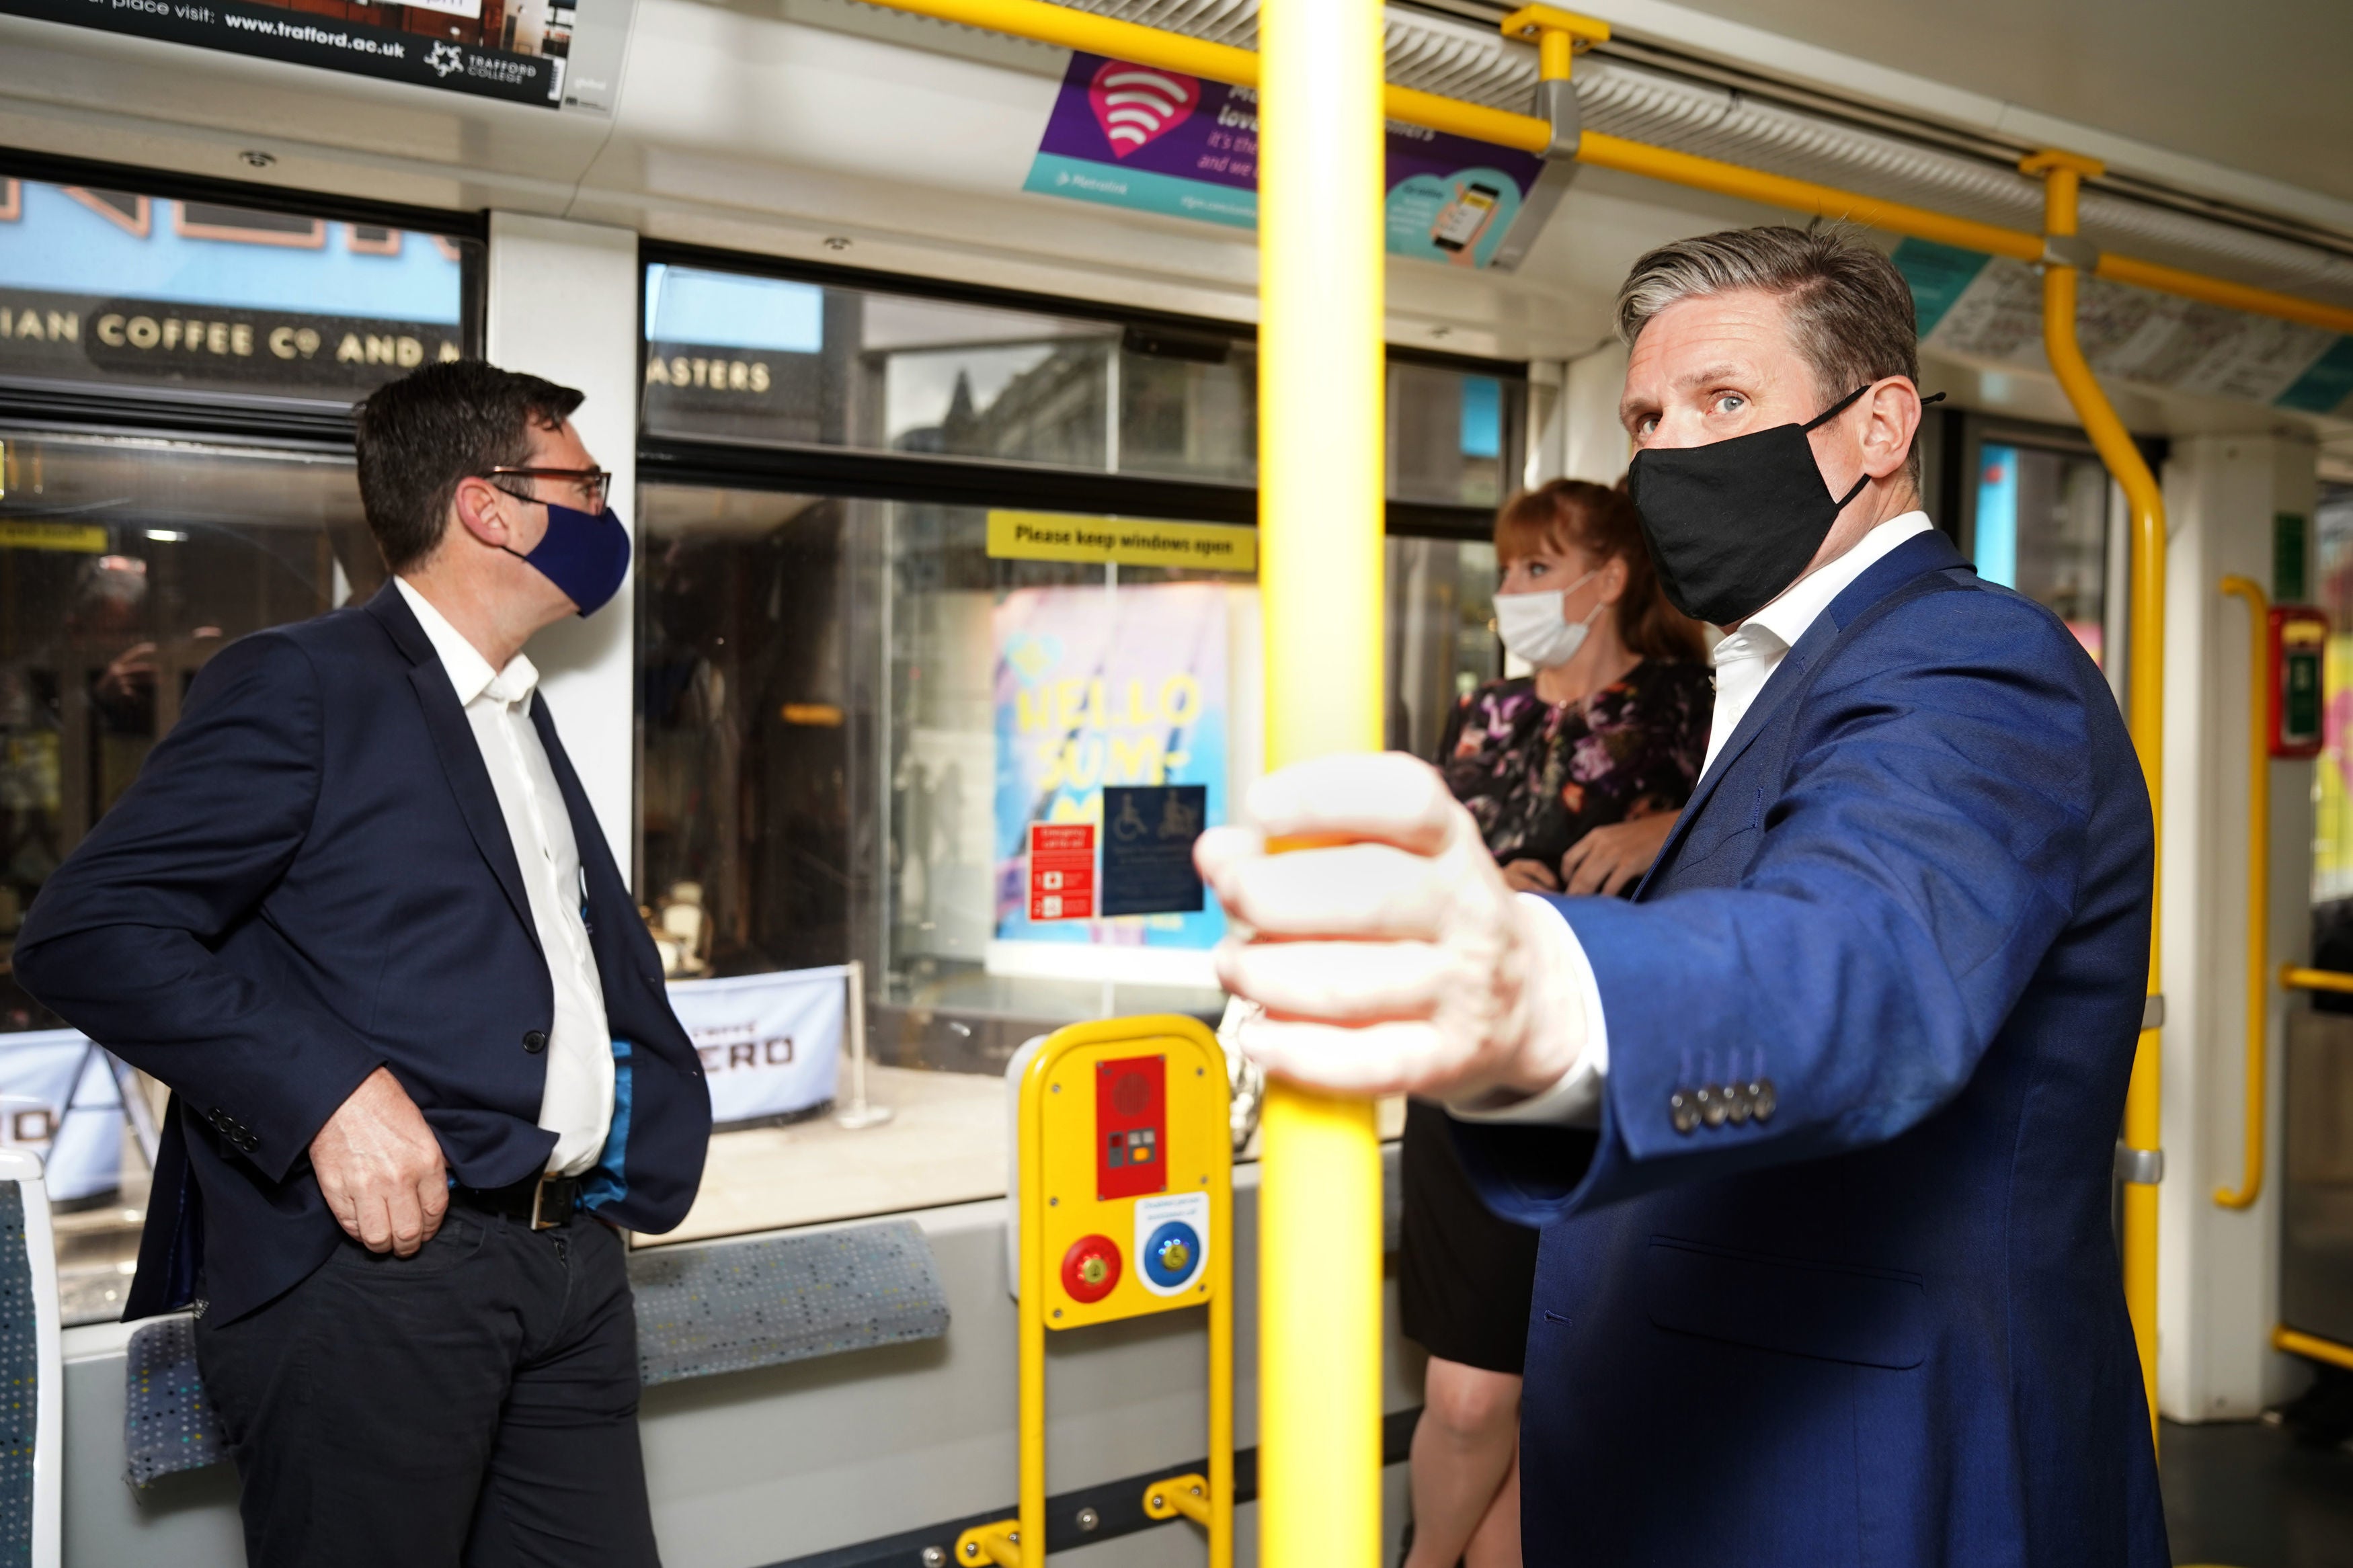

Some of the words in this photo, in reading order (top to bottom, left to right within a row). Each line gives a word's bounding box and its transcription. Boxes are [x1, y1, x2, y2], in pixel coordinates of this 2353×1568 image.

[174, 4, 215, 24] visit:
[225, 13, 405, 58] www.trafford.ac.uk
[467, 65, 522, 84] COLLEGE
[469, 54, 536, 77] TRAFFORD
[1197, 154, 1230, 172] and
[97, 313, 253, 356] COFFEE
[336, 332, 423, 368] AND
[1015, 524, 1072, 544] Please
[1076, 527, 1116, 551] keep
[1120, 530, 1191, 551] windows
[1193, 539, 1234, 556] open
[1016, 674, 1201, 735] HELLO
